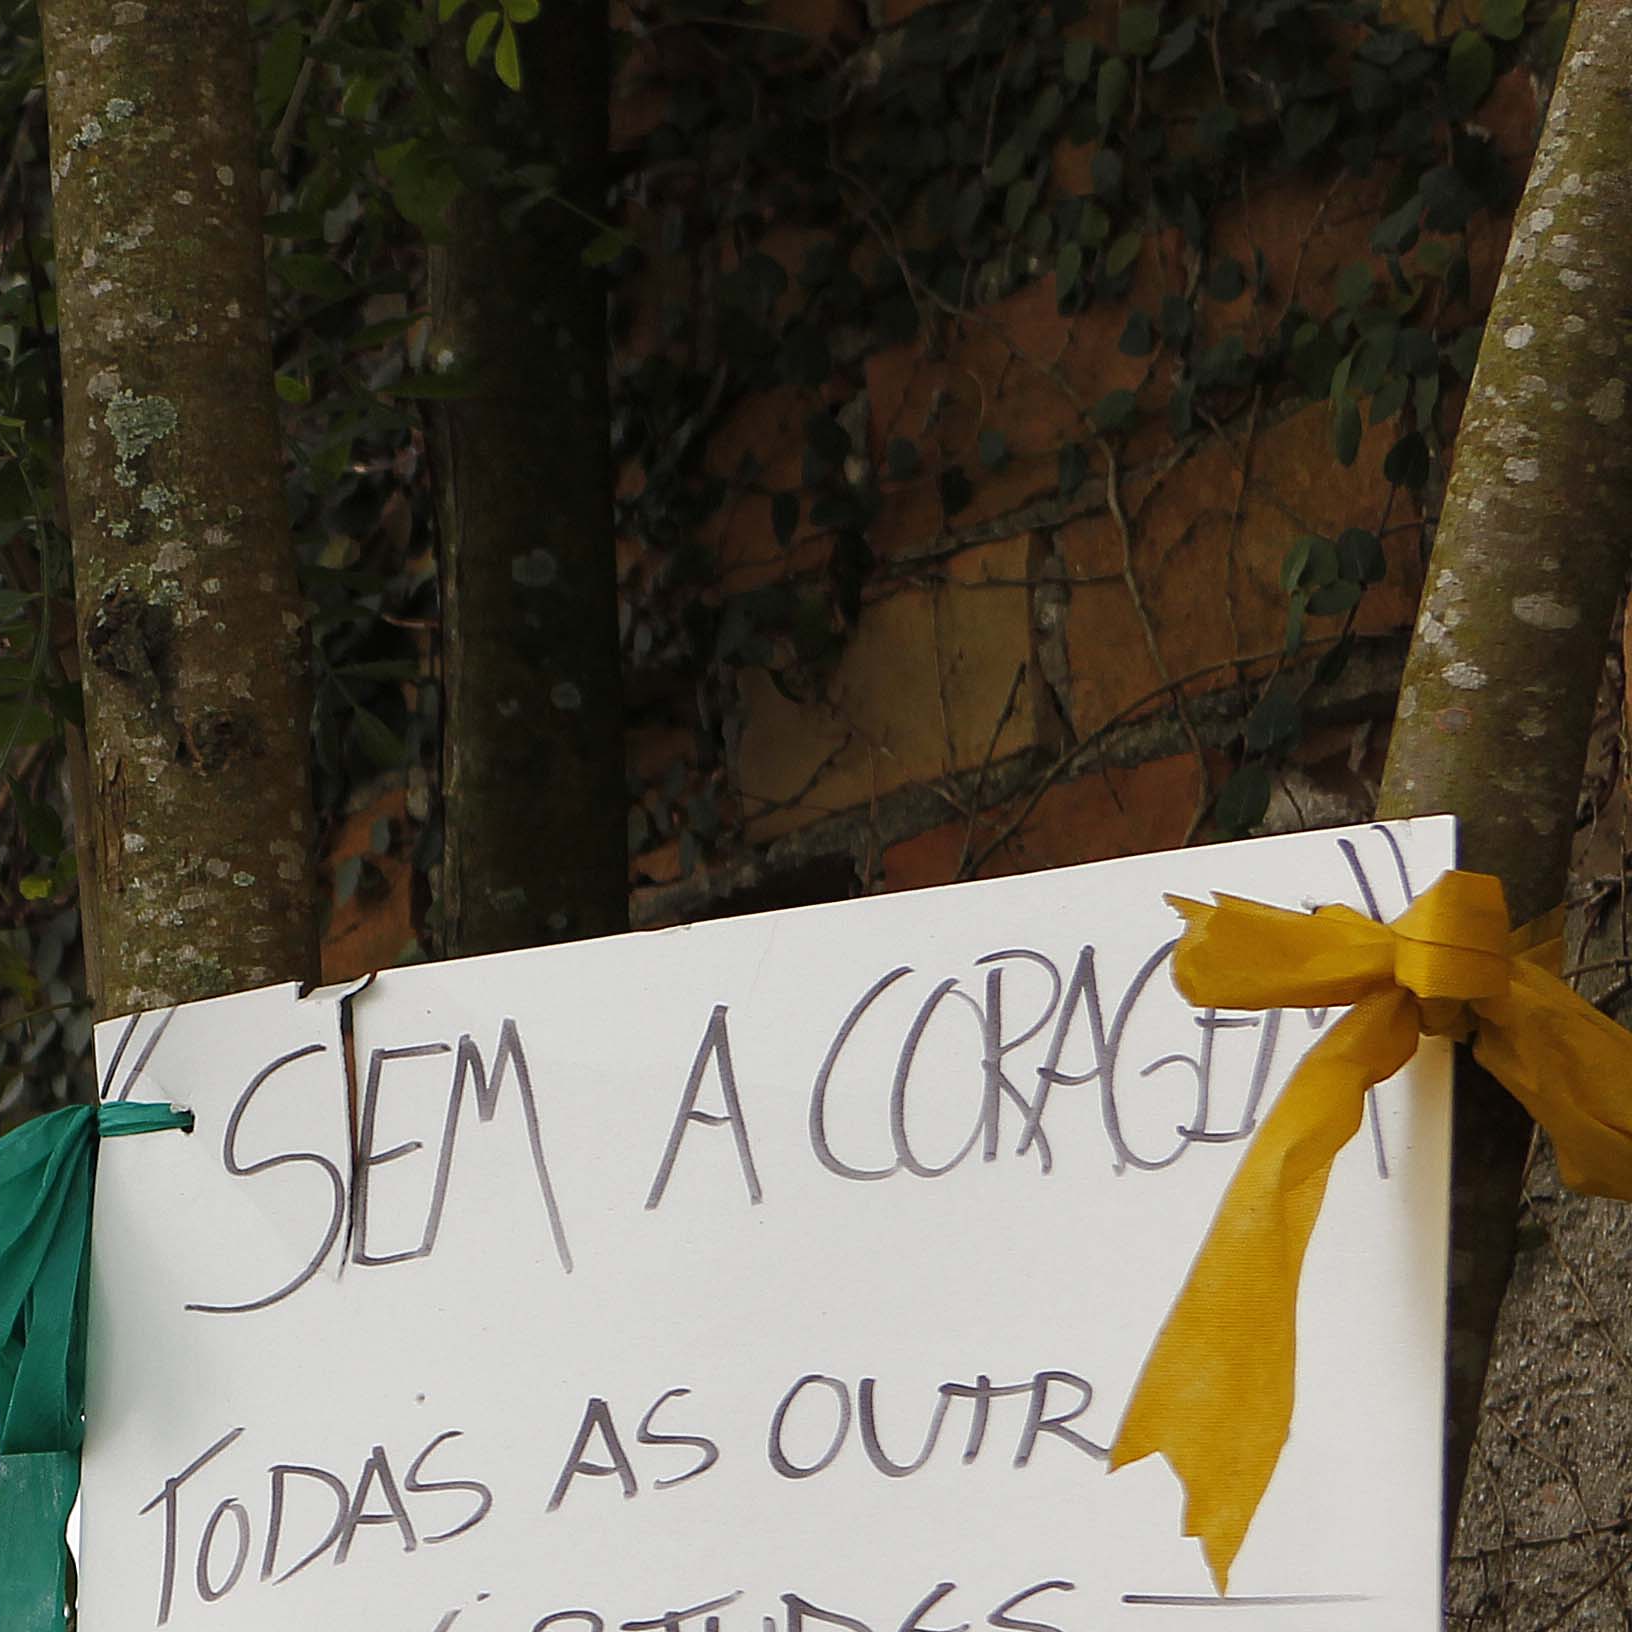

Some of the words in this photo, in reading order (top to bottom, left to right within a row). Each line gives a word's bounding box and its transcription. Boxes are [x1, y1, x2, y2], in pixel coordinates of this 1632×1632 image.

[186, 1018, 574, 1314] SEM
[644, 1004, 764, 1210] A
[138, 1425, 494, 1626] TODAS
[546, 1386, 720, 1514] AS
[766, 1370, 1112, 1478] OUTR
